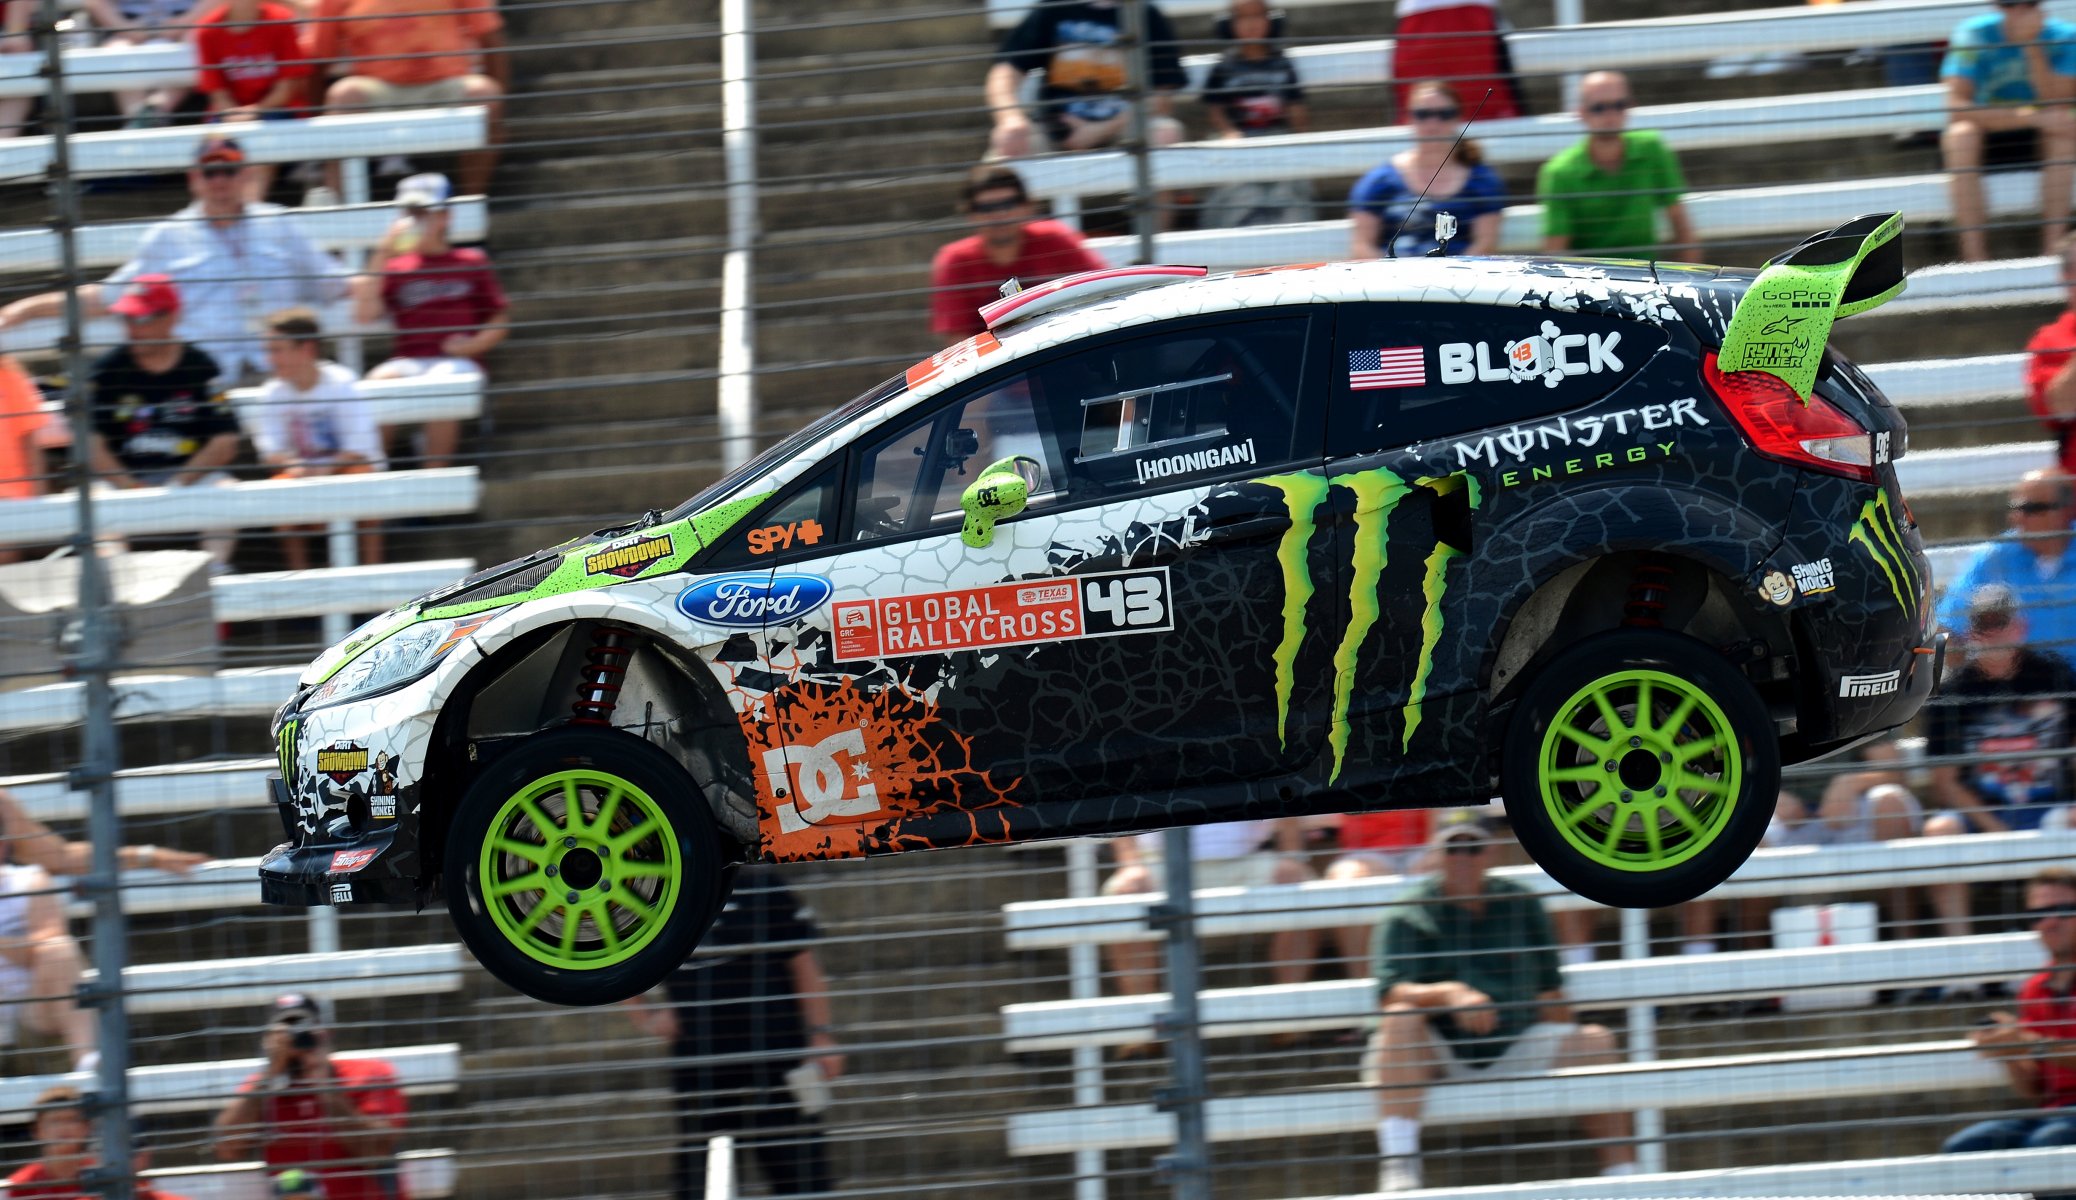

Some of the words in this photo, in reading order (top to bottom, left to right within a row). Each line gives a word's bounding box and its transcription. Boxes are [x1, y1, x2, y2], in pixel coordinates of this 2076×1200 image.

[1762, 290, 1832, 301] GoPro
[1512, 343, 1533, 362] 43
[1741, 356, 1803, 369] POWER
[1452, 397, 1710, 468] MONSTER
[1875, 430, 1890, 465] DC
[1502, 441, 1675, 487] ENERGY
[977, 486, 1001, 508] DC
[586, 537, 672, 573] SHOWDOWN
[708, 581, 801, 619] Ford
[1038, 587, 1068, 599] TEXAS
[1086, 576, 1164, 627] 43
[884, 592, 1000, 626] GLOBAL
[840, 629, 855, 638] GRC
[887, 609, 1076, 650] RALLYCROSS
[1839, 669, 1900, 698] PIRELLI
[762, 728, 881, 834] DC
[370, 795, 396, 806] SHINING
[371, 806, 396, 817] MONKEY
